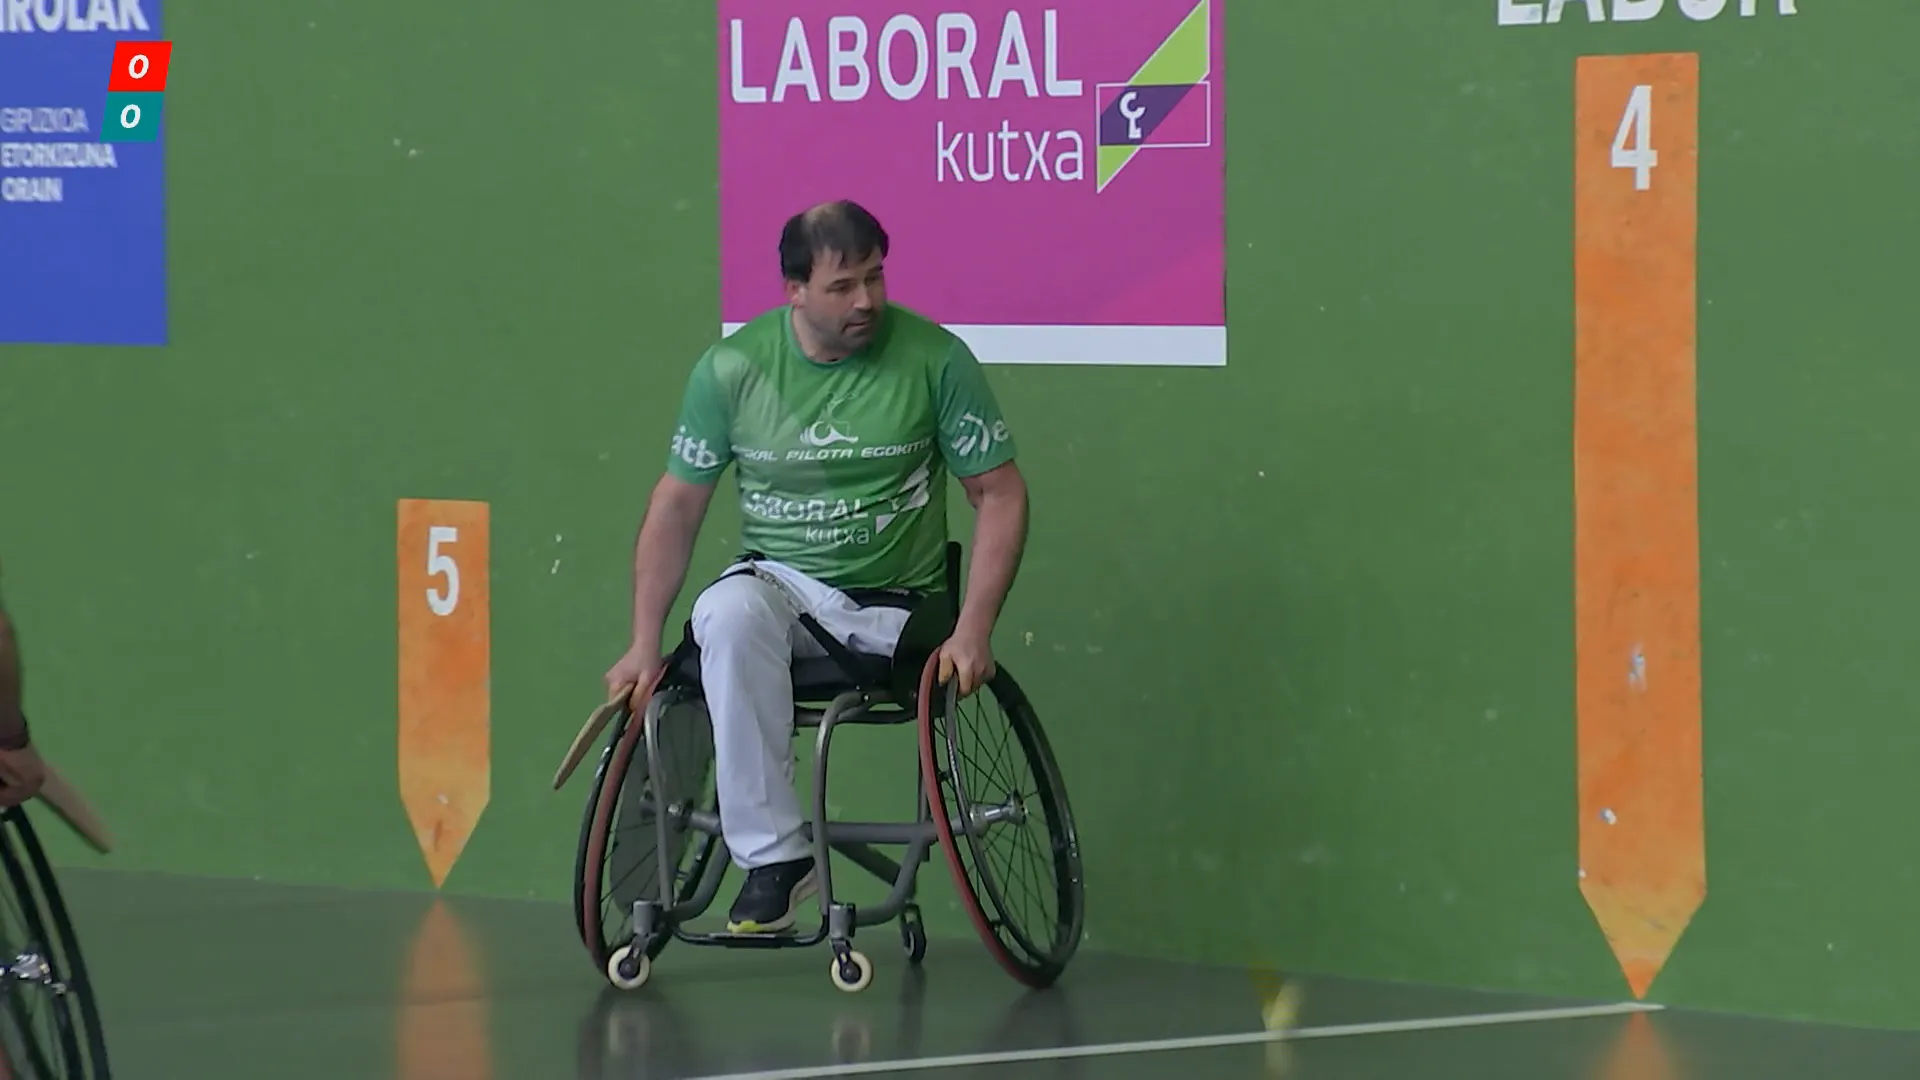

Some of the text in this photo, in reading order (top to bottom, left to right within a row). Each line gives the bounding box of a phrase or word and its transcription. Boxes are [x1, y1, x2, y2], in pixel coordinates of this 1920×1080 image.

[730, 9, 1083, 103] LABORAL
[937, 120, 1084, 182] kutxa
[1611, 84, 1658, 190] 4
[1, 177, 63, 202] ORAIN
[671, 425, 718, 468] itb
[786, 448, 853, 460] PILOTA
[806, 526, 870, 545] kutxa
[426, 526, 460, 616] 5
